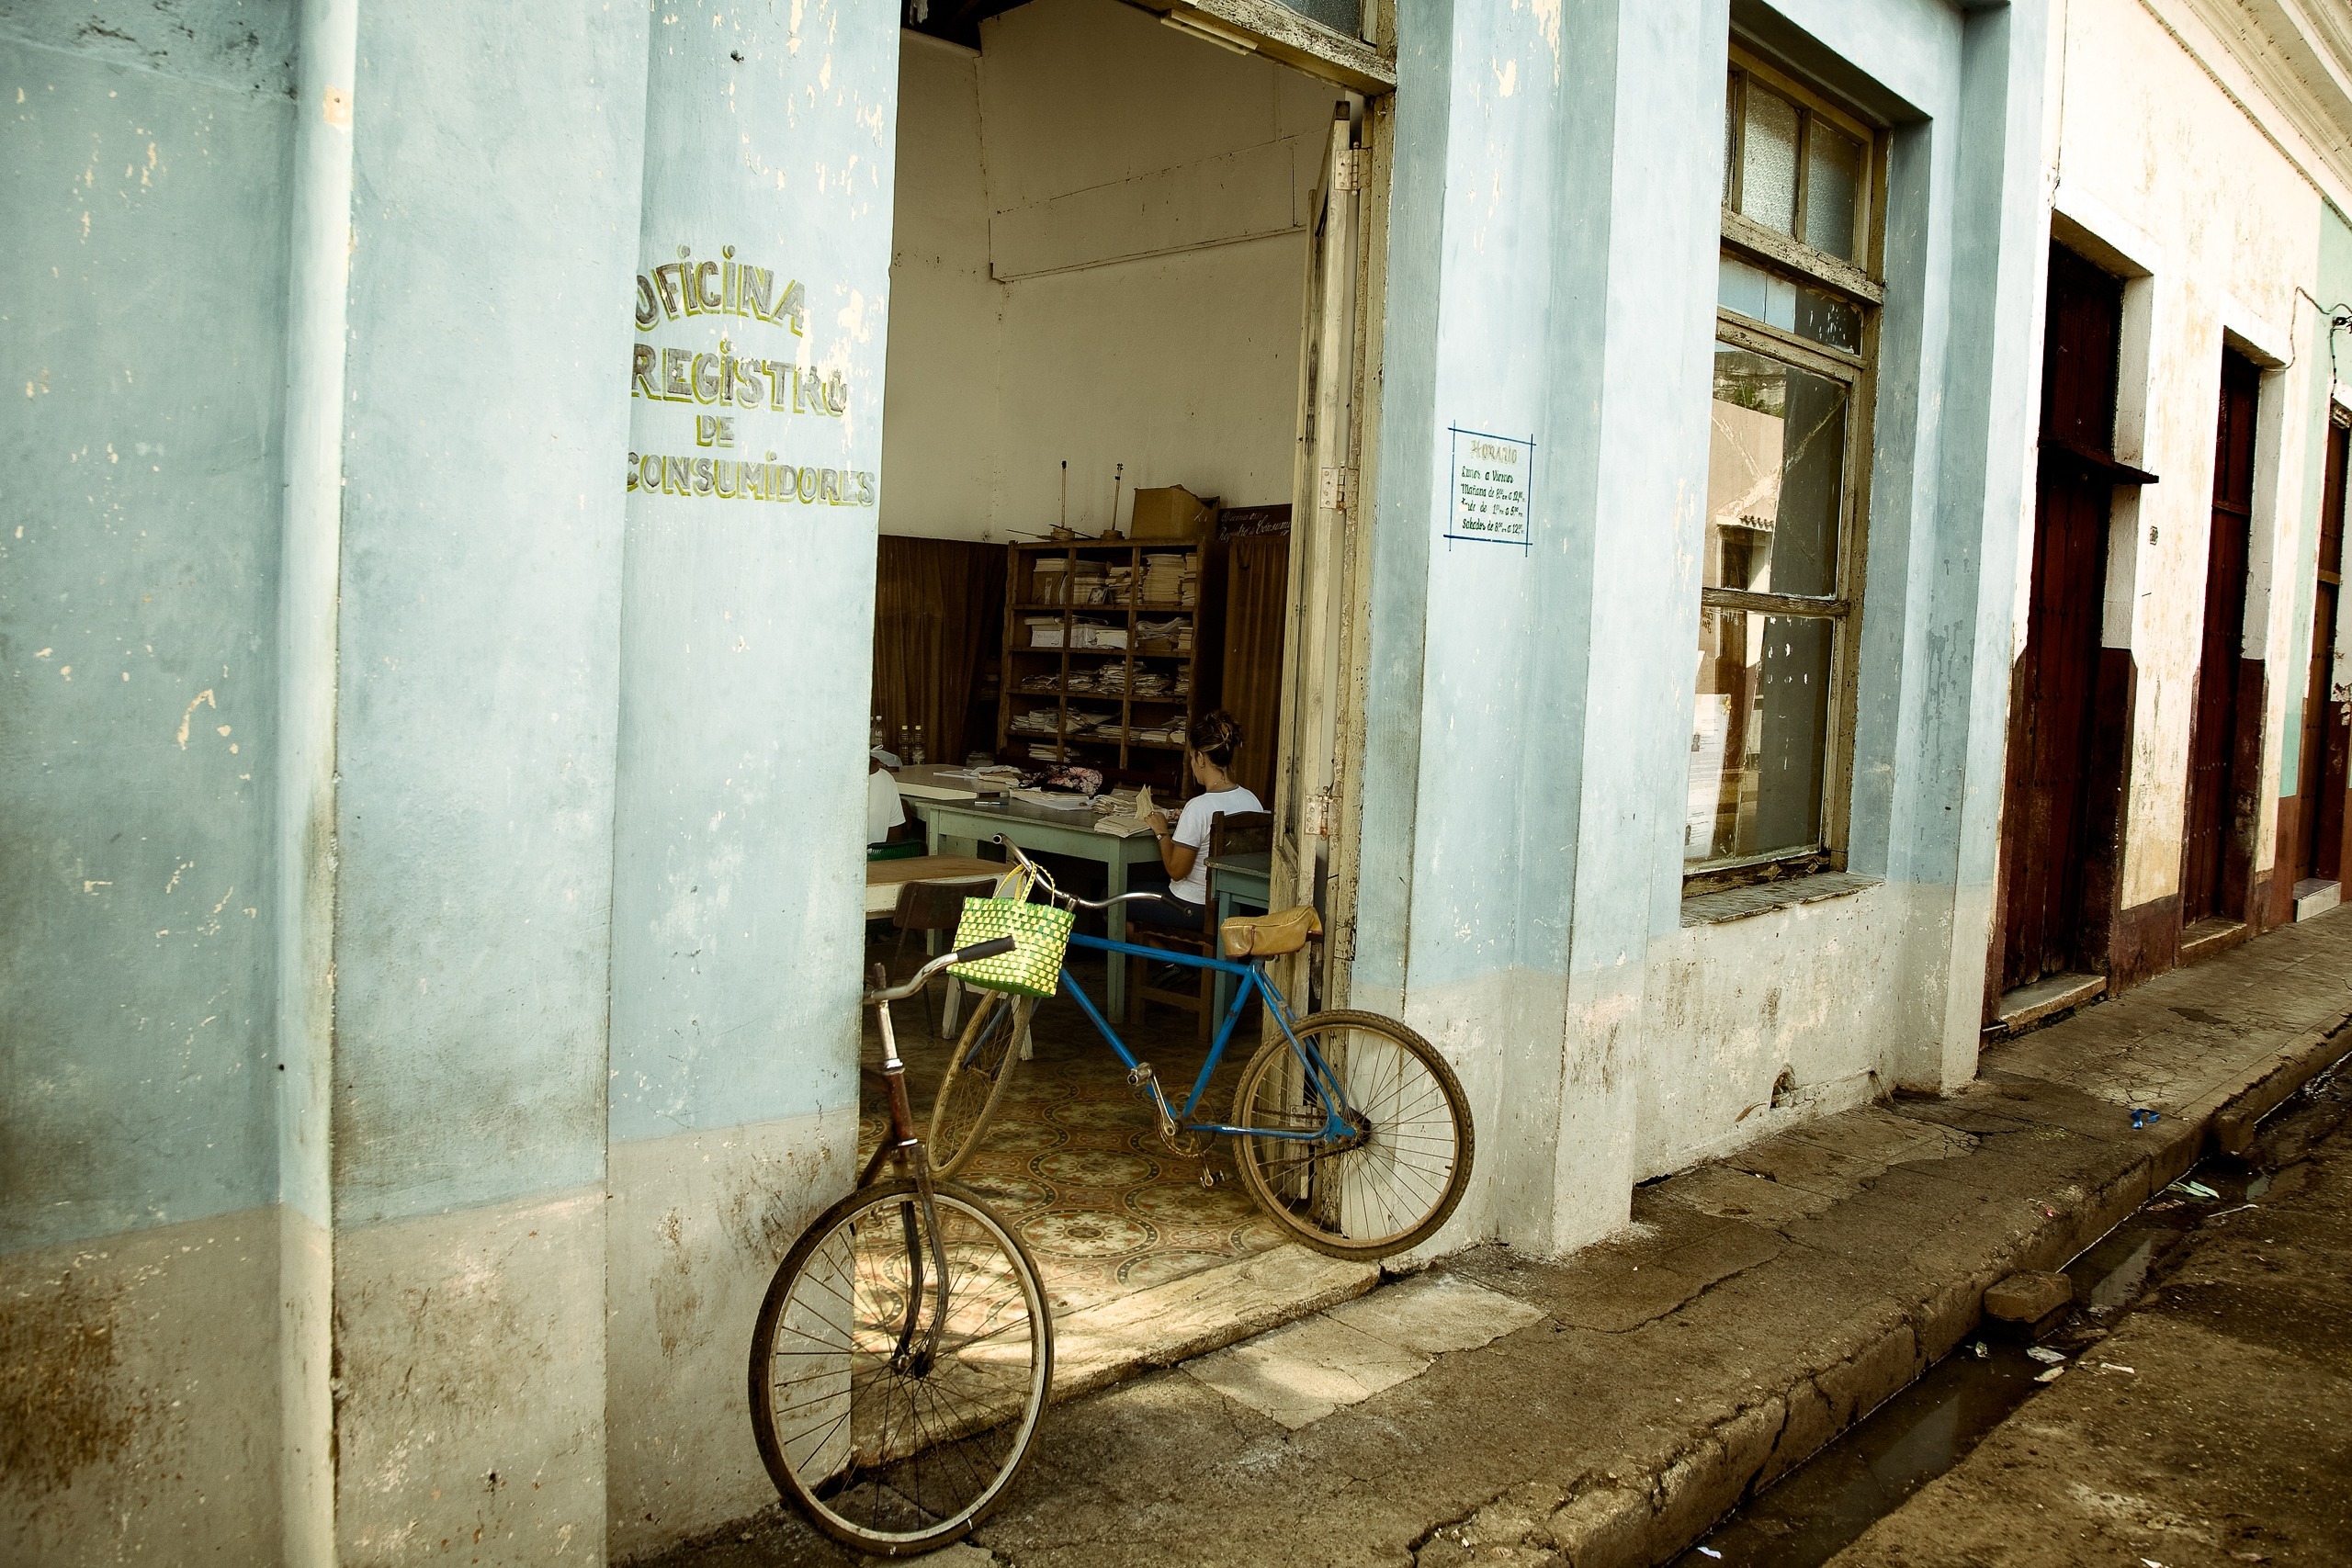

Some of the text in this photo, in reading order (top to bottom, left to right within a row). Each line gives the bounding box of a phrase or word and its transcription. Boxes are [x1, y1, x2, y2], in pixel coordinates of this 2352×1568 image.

[635, 244, 805, 336] OFICINA
[631, 338, 847, 417] REGISTRO
[696, 415, 735, 447] DE
[1470, 440, 1518, 464] HORARIO
[627, 450, 876, 506] CONSUMIDORES
[1461, 466, 1481, 479] Lunes
[1461, 483, 1487, 497] Mañana
[1488, 487, 1495, 497] de
[1480, 501, 1487, 513] de
[1487, 520, 1494, 531] de
